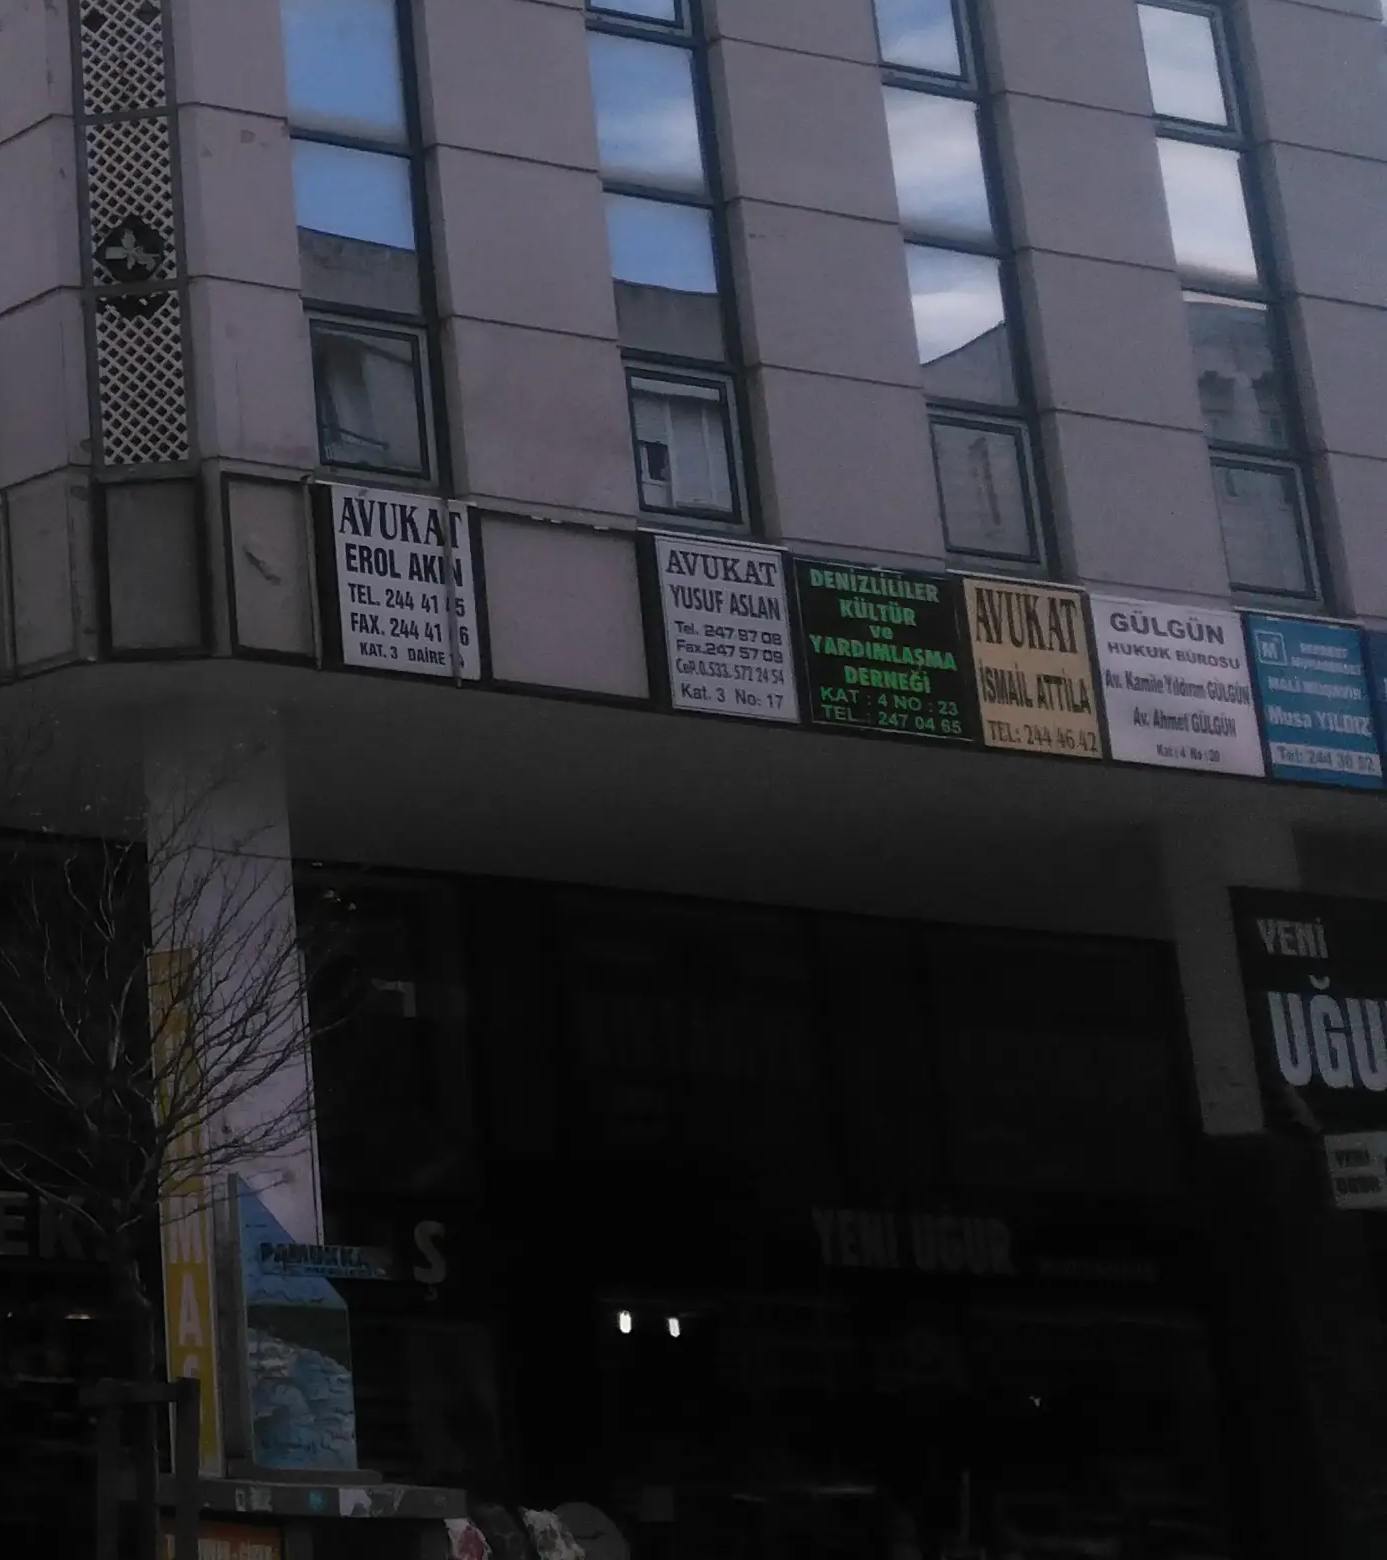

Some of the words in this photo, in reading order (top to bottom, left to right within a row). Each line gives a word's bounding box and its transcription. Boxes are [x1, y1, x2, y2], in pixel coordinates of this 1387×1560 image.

[339, 496, 463, 549] AVUKAT
[345, 543, 401, 579] EROL
[665, 549, 777, 587] AVUKAT
[348, 582, 380, 607] TEL.
[385, 588, 414, 611] 244
[421, 593, 438, 614] 41
[446, 597, 466, 618] 5
[810, 567, 941, 603] DENİZLİLİLER
[667, 584, 723, 613] YUSUF
[730, 592, 780, 621] ASLAN
[839, 596, 917, 627] KÜLTÜR
[350, 612, 385, 635] FAX.
[390, 618, 419, 640] 244
[424, 622, 442, 643] 41
[674, 621, 699, 636] Tel.
[705, 624, 734, 640] 247
[868, 624, 894, 640] ve
[975, 587, 1079, 654] AVUKAT
[1110, 610, 1225, 645] GÜLGÜN
[360, 642, 387, 658] KAT.
[390, 646, 398, 659] 3
[407, 647, 446, 665] DAİRE
[739, 646, 759, 661] 57
[809, 633, 957, 671] YARDIMLAŞMA
[1107, 642, 1171, 660] HUKUK
[844, 664, 931, 694] DERNEĞİ
[979, 659, 1033, 708] İSMAİL
[1036, 667, 1092, 716] ATTİLA
[681, 683, 711, 700] Kat.
[716, 687, 725, 702] 3
[767, 693, 783, 710] 17
[819, 686, 859, 704] KAT
[878, 692, 889, 708] 4
[894, 694, 923, 712] NO
[937, 700, 959, 716] 23
[878, 711, 909, 728] 247
[915, 715, 935, 732] 04
[940, 718, 963, 735] 65
[986, 719, 1021, 744] TEL:
[1024, 724, 1052, 747] 244
[1153, 708, 1189, 732] Ahmet
[1191, 710, 1237, 737] GÜLGÜN
[1256, 916, 1330, 959] YENİ
[1267, 972, 1387, 1092] UĞU
